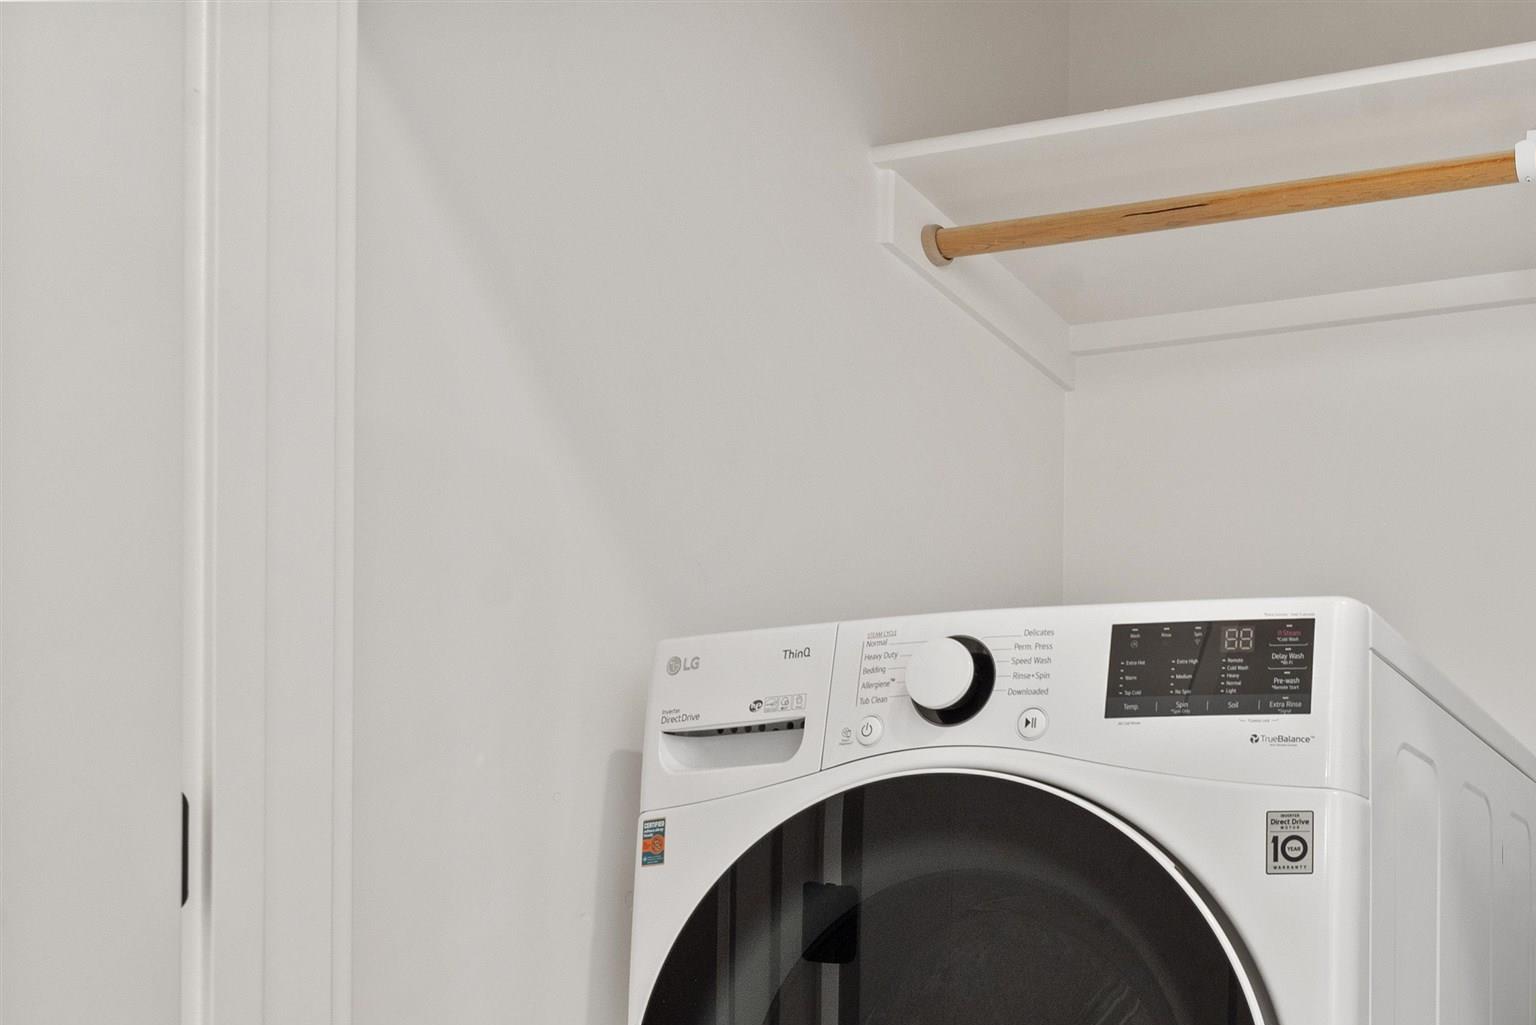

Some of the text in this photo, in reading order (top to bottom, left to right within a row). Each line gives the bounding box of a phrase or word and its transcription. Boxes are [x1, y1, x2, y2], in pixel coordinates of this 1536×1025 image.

[1023, 628, 1055, 637] Delicates
[866, 639, 888, 647] Normal
[1034, 642, 1053, 650] Press
[783, 647, 811, 660] ThinQ
[864, 651, 898, 661] Heavy Duty
[1271, 653, 1288, 661] Delay
[1011, 656, 1052, 665] Speed Wash
[862, 667, 886, 675] Bedding
[1007, 687, 1049, 696] Downloaded
[859, 696, 888, 705] Tub Clean
[1175, 700, 1188, 709] Spin
[1227, 701, 1239, 709] Soil
[1261, 735, 1311, 744] TrueBalance
[1272, 835, 1308, 862] 10
